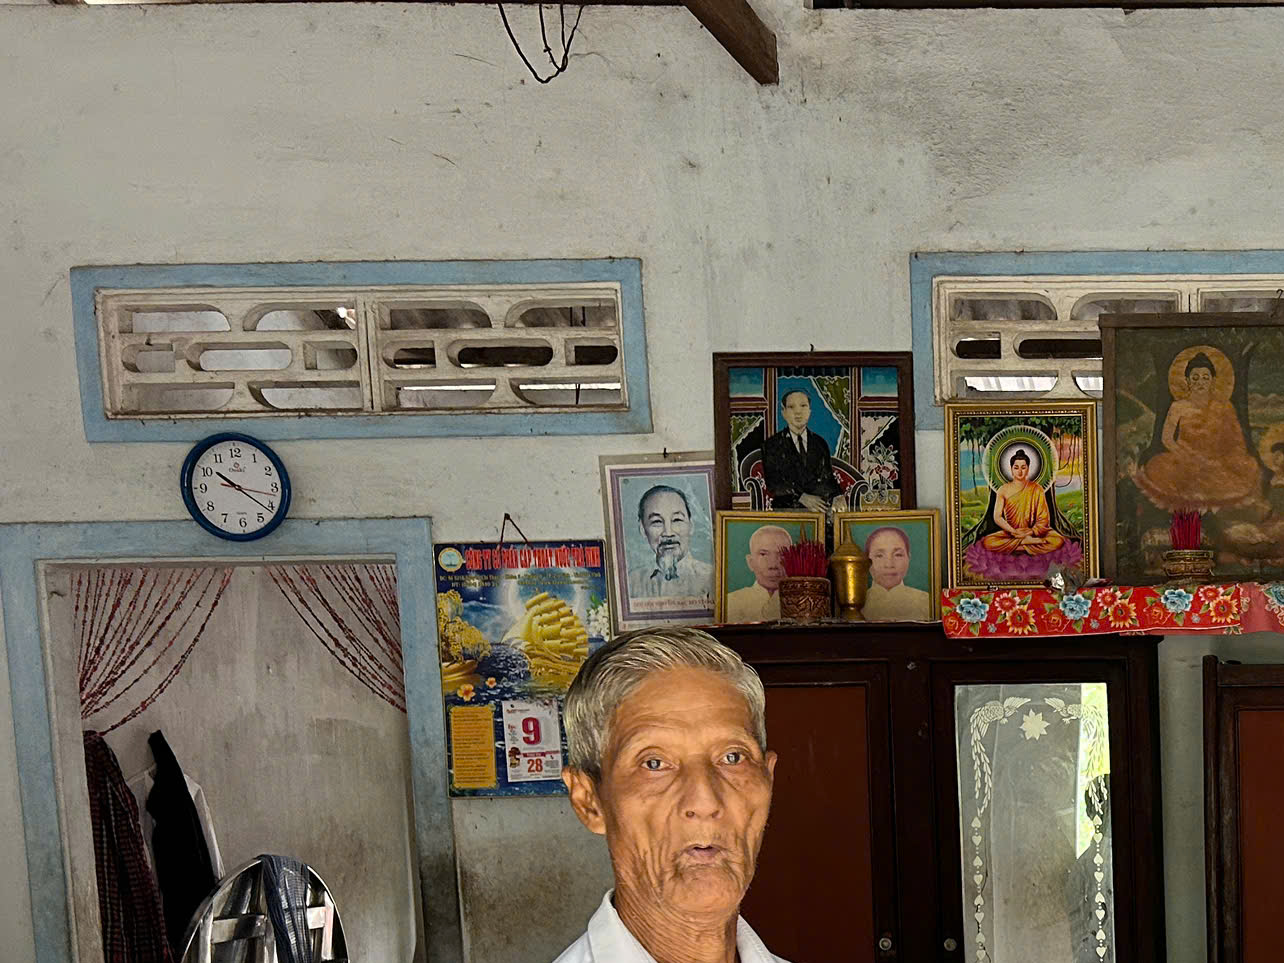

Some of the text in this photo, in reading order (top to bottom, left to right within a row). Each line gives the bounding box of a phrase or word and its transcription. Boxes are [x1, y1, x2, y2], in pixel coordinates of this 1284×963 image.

[229, 447, 241, 458] 12
[214, 453, 222, 463] 11
[252, 453, 257, 463] 1
[202, 467, 213, 477] 10
[264, 466, 272, 476] 2
[200, 483, 207, 493] 9
[271, 482, 278, 493] 3
[206, 501, 214, 512] 8
[268, 500, 275, 511] 4
[221, 513, 228, 523] 7
[256, 512, 264, 523] 5
[239, 518, 247, 528] 6
[522, 717, 541, 745] 9
[527, 758, 543, 773] 28
